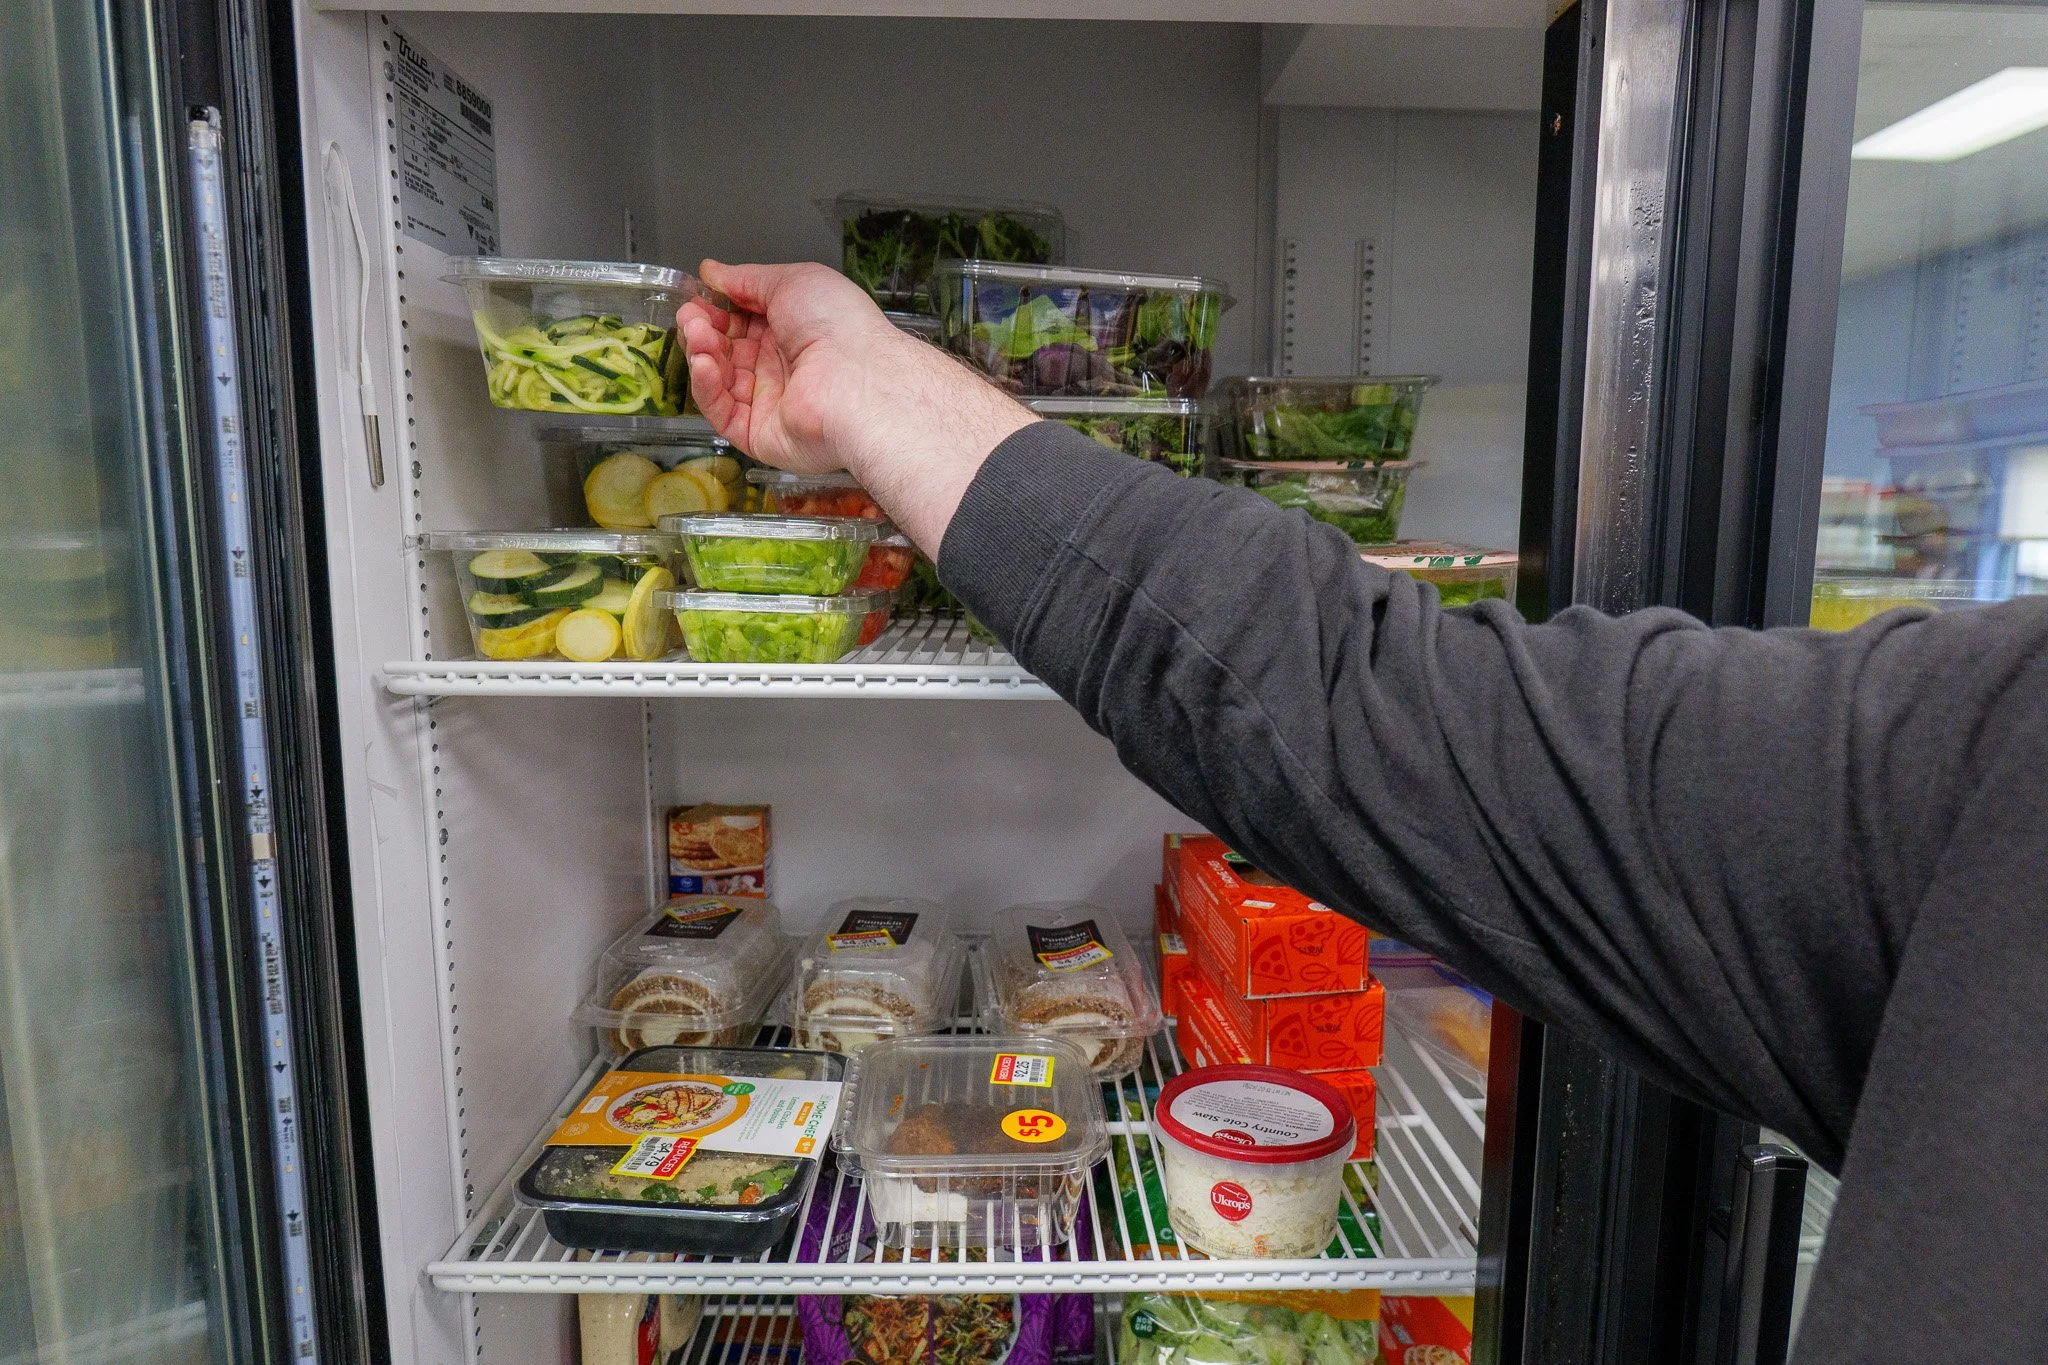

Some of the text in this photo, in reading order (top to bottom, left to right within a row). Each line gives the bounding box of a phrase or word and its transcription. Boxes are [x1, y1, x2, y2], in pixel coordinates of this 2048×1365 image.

[998, 1057, 1012, 1080] REDUCED
[1013, 1060, 1030, 1078] $2.25
[811, 1100, 828, 1119] HOME
[1018, 1115, 1054, 1137] $5
[1192, 1111, 1299, 1140] Country Cole Slaw
[644, 1142, 673, 1168] $4.79
[661, 1140, 691, 1173] REDUCED
